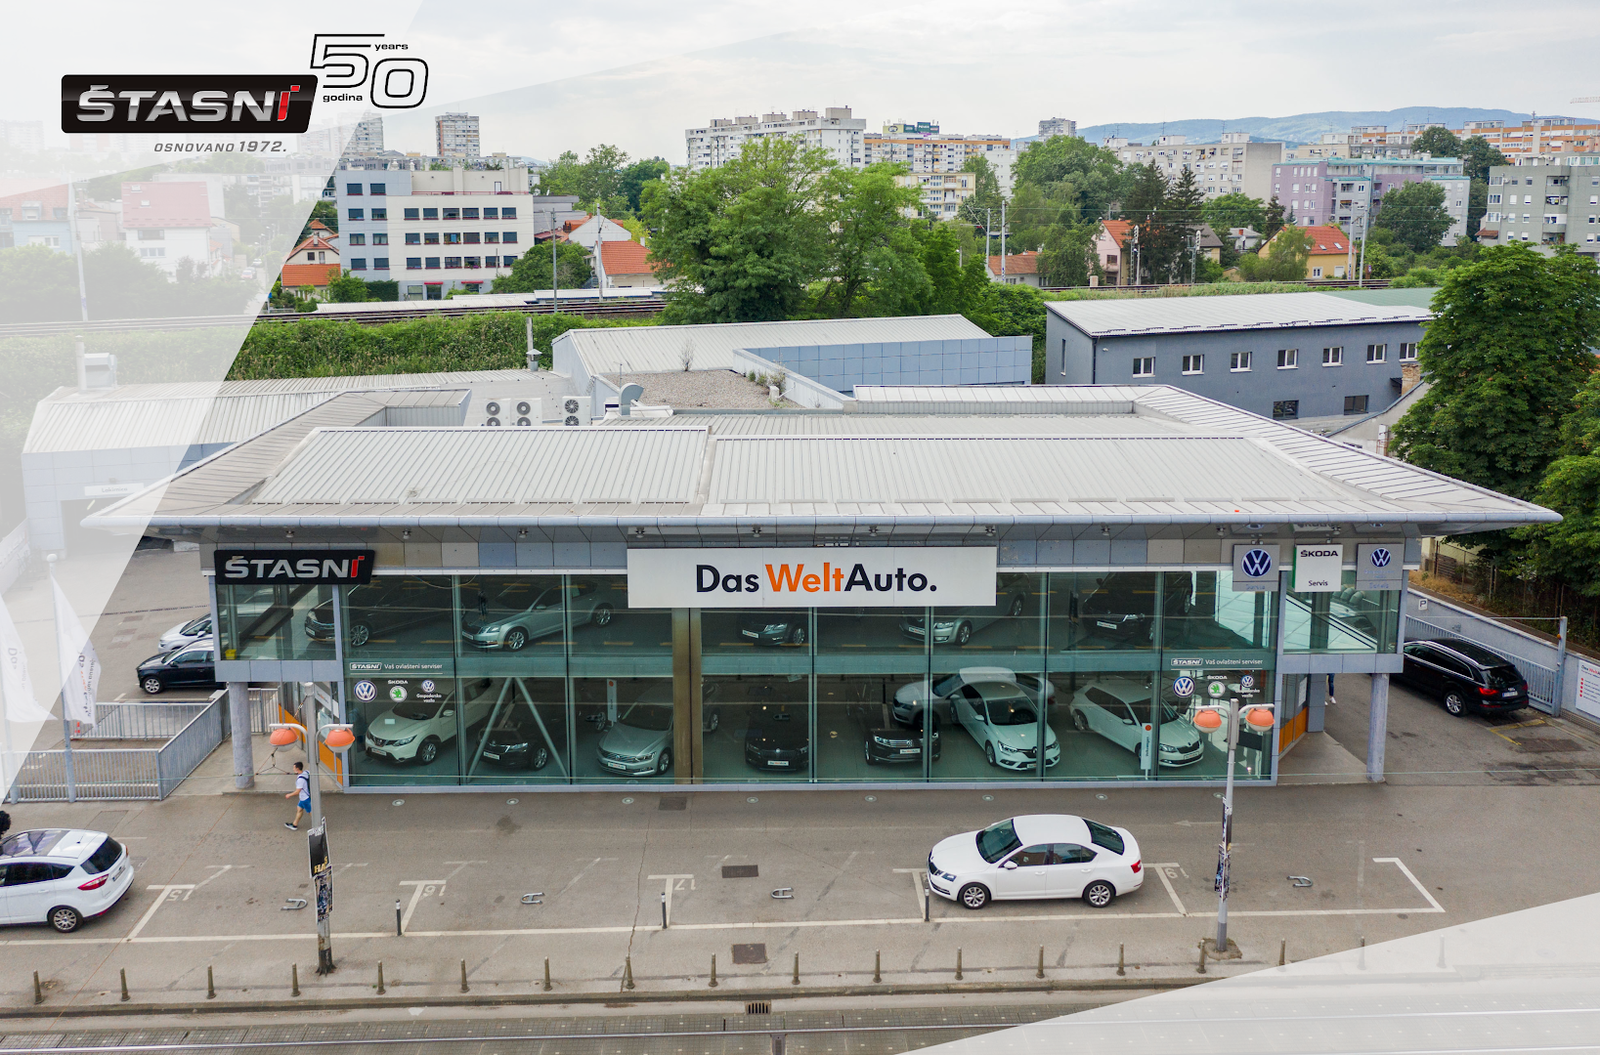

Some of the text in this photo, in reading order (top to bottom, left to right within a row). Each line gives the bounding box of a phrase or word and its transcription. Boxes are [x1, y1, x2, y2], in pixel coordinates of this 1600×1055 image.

[1300, 549, 1339, 558] ŠKODA
[696, 564, 760, 593] Das
[1308, 579, 1329, 587] Servis
[674, 878, 697, 891] 17
